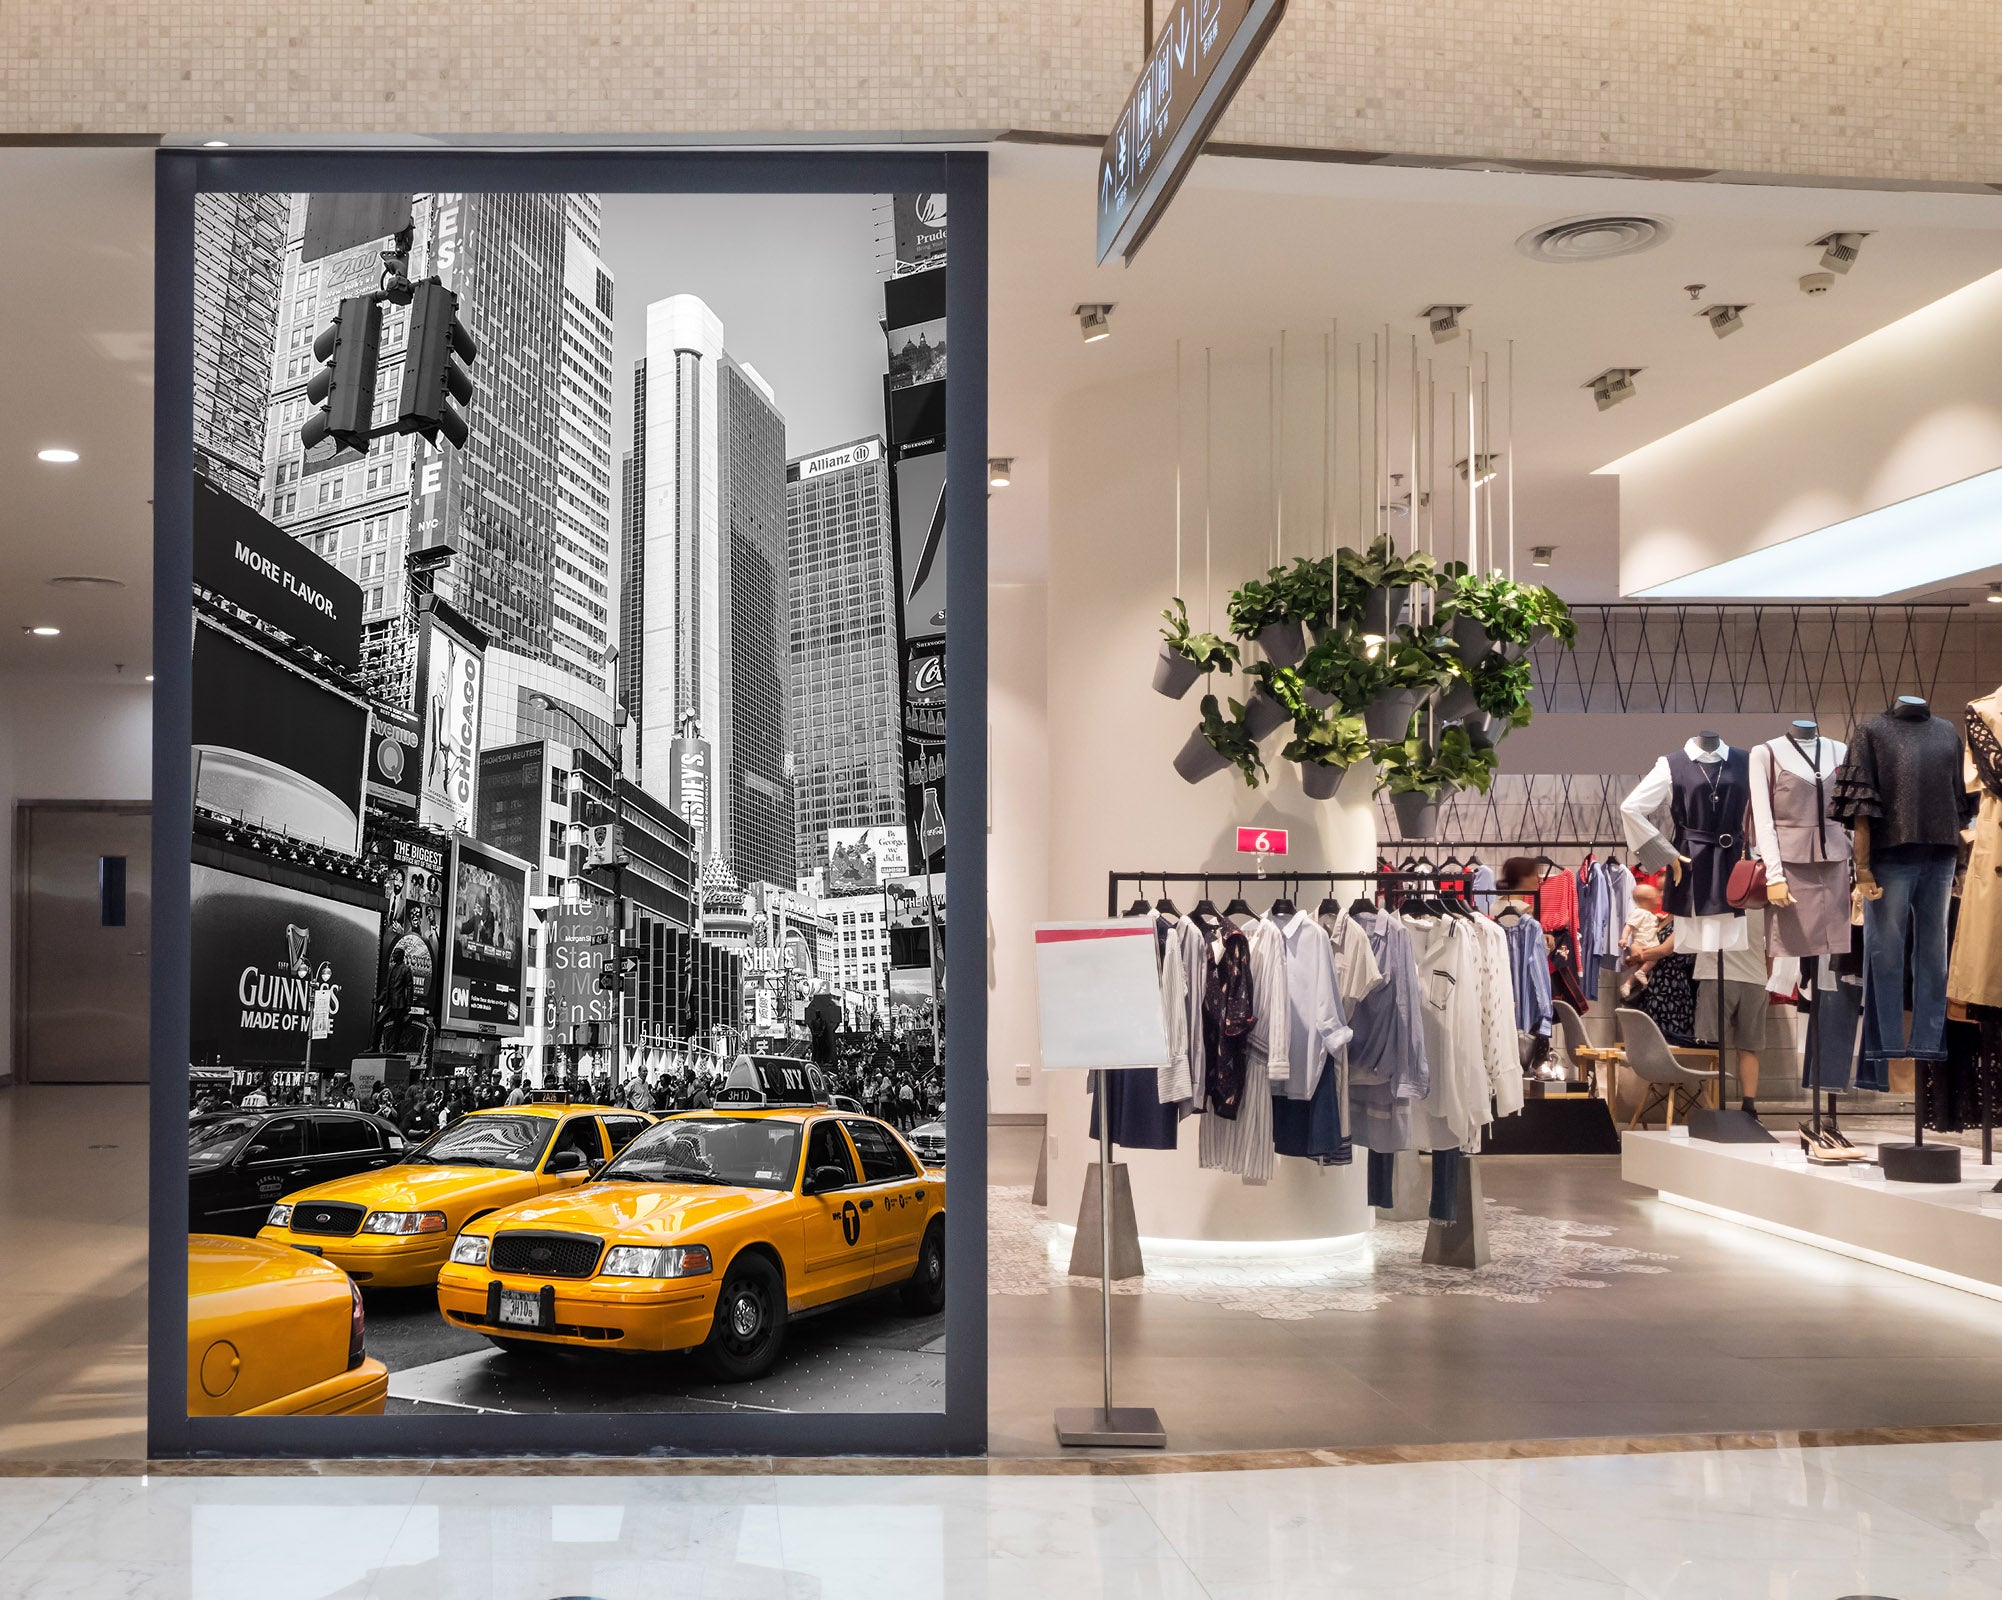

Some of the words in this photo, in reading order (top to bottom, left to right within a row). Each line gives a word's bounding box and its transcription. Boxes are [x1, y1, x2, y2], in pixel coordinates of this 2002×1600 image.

[808, 453, 850, 474] Allianz
[418, 519, 438, 532] NYC
[234, 540, 280, 584] MORE
[282, 570, 337, 621] FLAVOR.
[938, 610, 946, 619] S
[371, 713, 418, 748] Avenue
[457, 658, 476, 803] CHICAGO
[377, 738, 404, 784] Q
[480, 753, 512, 765] THOMSON
[512, 748, 542, 760] REUTERS
[1255, 832, 1270, 852] 6
[411, 845, 443, 866] BIGGEST
[239, 966, 340, 1015] GUINNS
[452, 987, 469, 1008] CNN
[240, 1010, 280, 1030] MADE
[281, 1014, 299, 1031] OF
[300, 1015, 334, 1034] ME
[758, 1067, 770, 1088] I
[781, 1068, 804, 1089] NY
[542, 1093, 557, 1102] 2A26
[728, 1091, 750, 1101] 3H10
[845, 1209, 856, 1240] T
